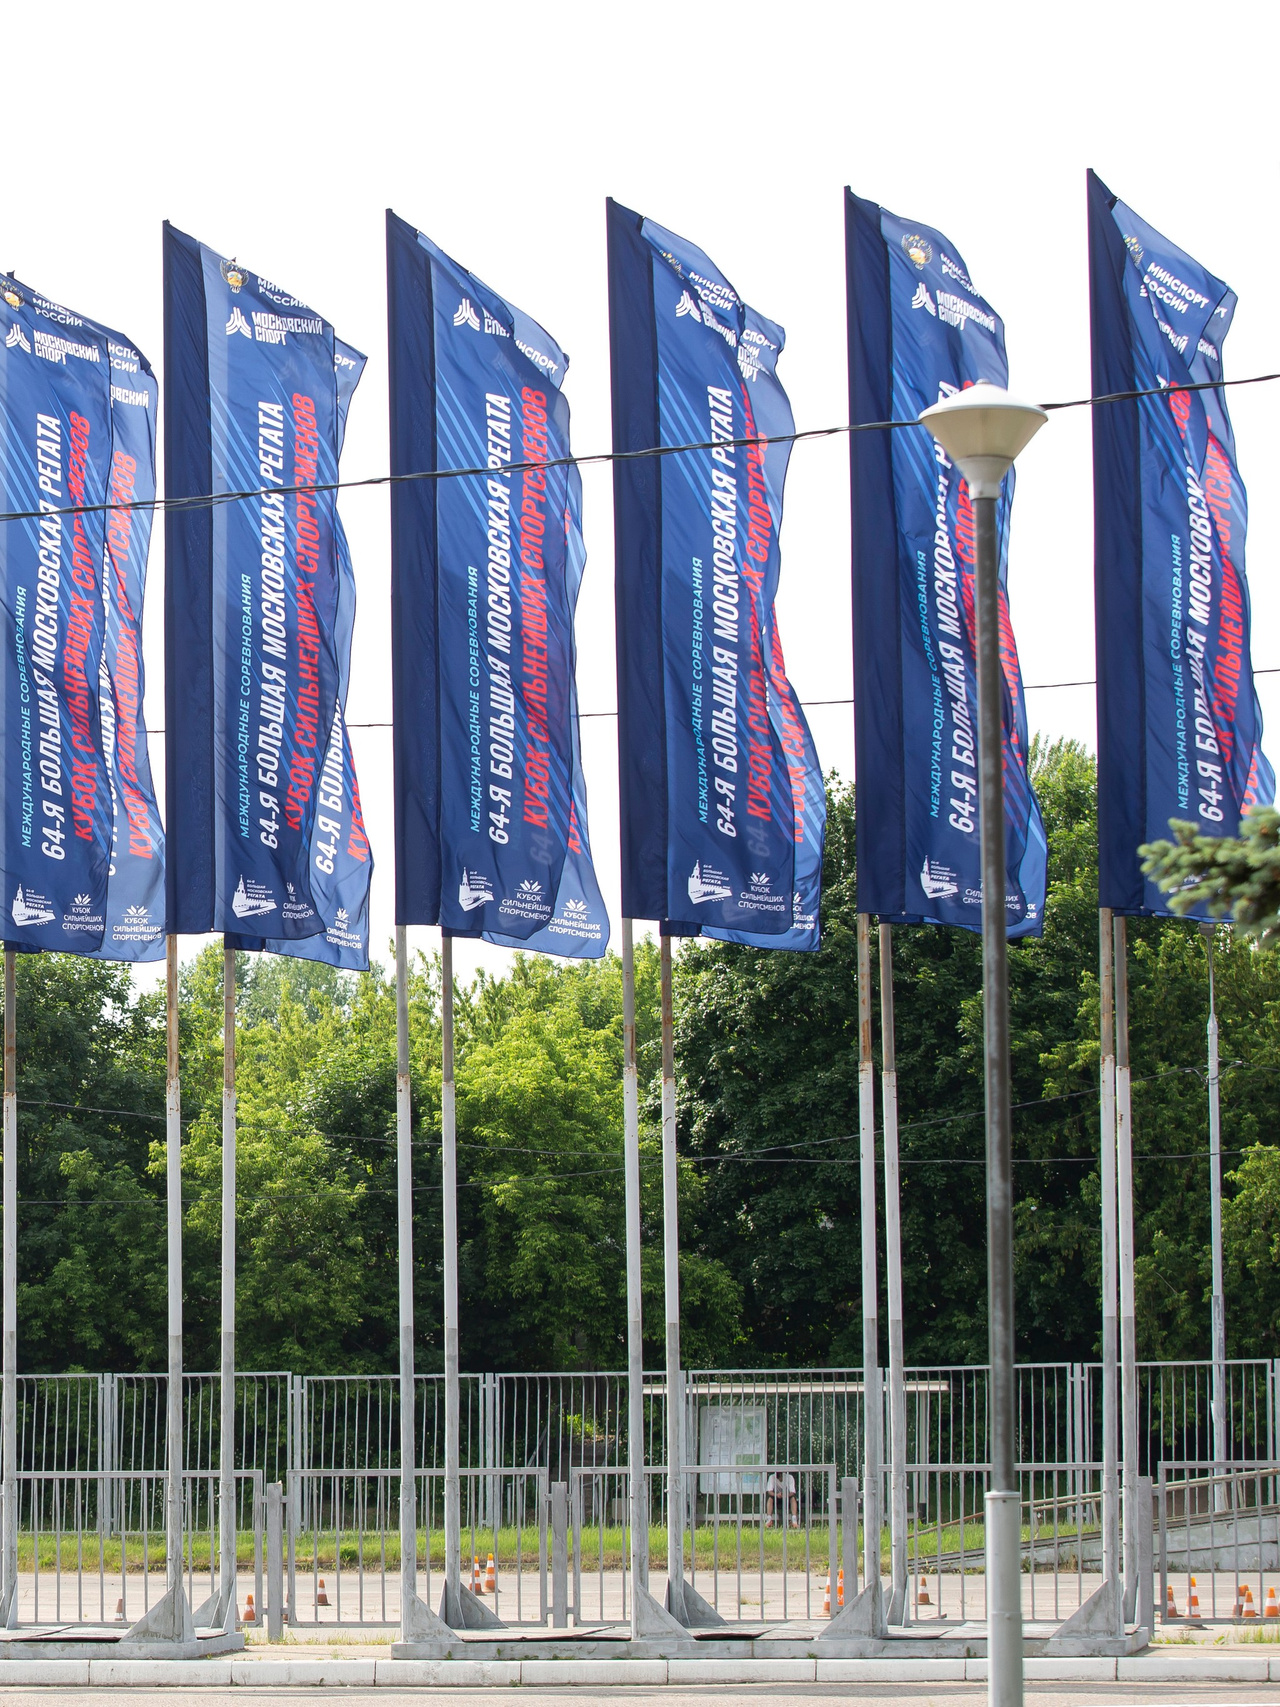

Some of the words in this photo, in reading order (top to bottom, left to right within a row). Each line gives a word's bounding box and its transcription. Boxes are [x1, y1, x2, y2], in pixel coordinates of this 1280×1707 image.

[34, 307, 82, 327] РОССИИ
[251, 312, 323, 336] МОСКОВСКИЙ
[258, 287, 310, 309] РОССИИ
[936, 290, 996, 334] МОСКОВСКИЙ
[938, 304, 967, 330] СПОРТ
[1142, 274, 1189, 314] РОССИИ
[1147, 262, 1210, 309] МИНСПОРТ
[33, 329, 100, 363] МОСКОВСКИЙ
[34, 343, 67, 365] СПОРТ
[255, 328, 287, 346] СПОРТ
[37, 414, 61, 497] РЕГАТА
[259, 402, 283, 485] РЕГАТА
[486, 393, 511, 477] РЕГАТА
[707, 386, 735, 468] РЕГАТА
[293, 393, 319, 573] СПОРТСМЕНОВ
[521, 387, 547, 569] СПОРТСМЕНОВ
[32, 499, 61, 672] МОСКОВСКАЯ
[260, 487, 286, 659] МОСКОВСКАЯ
[487, 479, 511, 653] МОСКОВСКАЯ
[711, 469, 739, 642] МОСКОВСКАЯ
[1171, 534, 1182, 659] СОРЕВНОВАНИЯ
[16, 586, 29, 702] СОРЕВНОВАНИЯ
[241, 574, 251, 695] СОРЕВНОВАНИЯ
[468, 566, 479, 686] СОРЕВНОВАНИЯ
[692, 557, 702, 679] СОРЕВНОВАНИЯ
[917, 550, 937, 671] СОРЕВНОВАНИЯ
[64, 591, 95, 753] СИЛЬНЕЙШИХ
[295, 577, 320, 747] СИЛЬНЕЙШИХ
[521, 572, 549, 742] СИЛЬНЕЙШИХ
[34, 674, 62, 795] БОЛЬШАЯ
[114, 621, 138, 783] СИЛЬНЕЙШИХ
[257, 662, 286, 787] БОЛЬШАЯ
[488, 655, 514, 779] БОЛЬШАЯ
[712, 646, 738, 773] БОЛЬШАЯ
[939, 641, 975, 767] БОЛЬШАЯ
[1173, 664, 1189, 809] МЕЖДУНАРОДНЫЕ
[21, 707, 33, 847] МЕЖДУНАРОДНЫЕ
[238, 699, 250, 838] МЕЖДУНАРОДНЫЕ
[470, 691, 482, 832] МЕЖДУНАРОДНЫЕ
[524, 744, 549, 828] КУБОК
[692, 683, 708, 823] МЕЖДУНАРОДНЫЕ
[748, 738, 772, 821] КУБОК
[930, 674, 945, 817] МЕЖДУНАРОДНЫЕ
[42, 800, 65, 859] 64-Я
[72, 758, 96, 840] КУБОК
[122, 783, 152, 859] КУБОК
[260, 791, 281, 850] 64-Я
[285, 752, 314, 830] КУБОК
[488, 785, 513, 844] 64-Я
[715, 777, 736, 837] 64-Я
[949, 771, 976, 832] 64-Я
[1197, 760, 1223, 821] 64-Я
[315, 815, 342, 875] 64-Я
[62, 923, 104, 931] СПОРТСМЕНОВ
[63, 914, 103, 923] СИЛЬНЕЙШИХ
[112, 923, 162, 933] СИЛЬНЕЙШИХ
[498, 906, 550, 921] СПОРТСМЕНО
[501, 898, 552, 913] СИЛЬНЕЙШИХ
[516, 892, 542, 902] КУБОК
[549, 917, 602, 931] СИЛЬНЕЙШИХ
[563, 911, 588, 921] КУБОК
[738, 900, 787, 912] СПОРТСМЕНОВ
[740, 891, 785, 903] СИЛЬНЕЙШИХ
[750, 885, 771, 894] КУБОК
[112, 932, 162, 941] СПОРТСМЕНОВ
[547, 925, 602, 939] СПОРТСМЕНОВ
